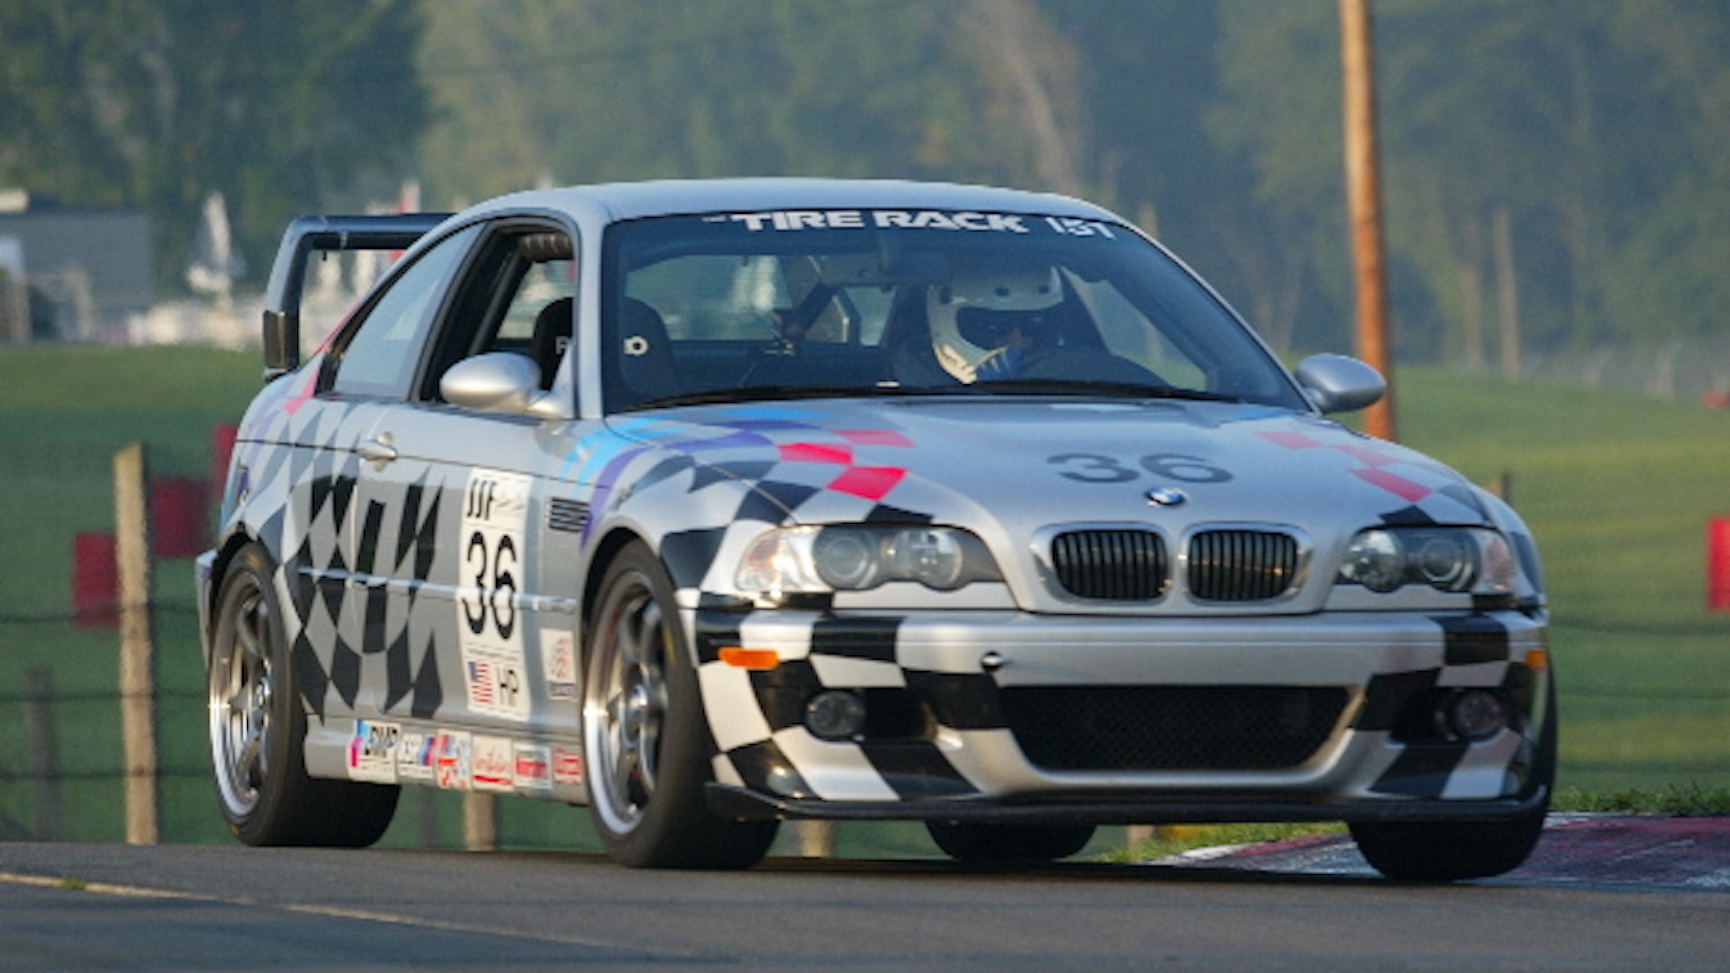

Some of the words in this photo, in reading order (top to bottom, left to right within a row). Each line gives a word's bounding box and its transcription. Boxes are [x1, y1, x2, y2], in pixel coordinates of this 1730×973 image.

[730, 210, 866, 231] TIRE
[872, 210, 1030, 234] RACK
[1046, 453, 1235, 483] 36
[462, 530, 517, 640] 36
